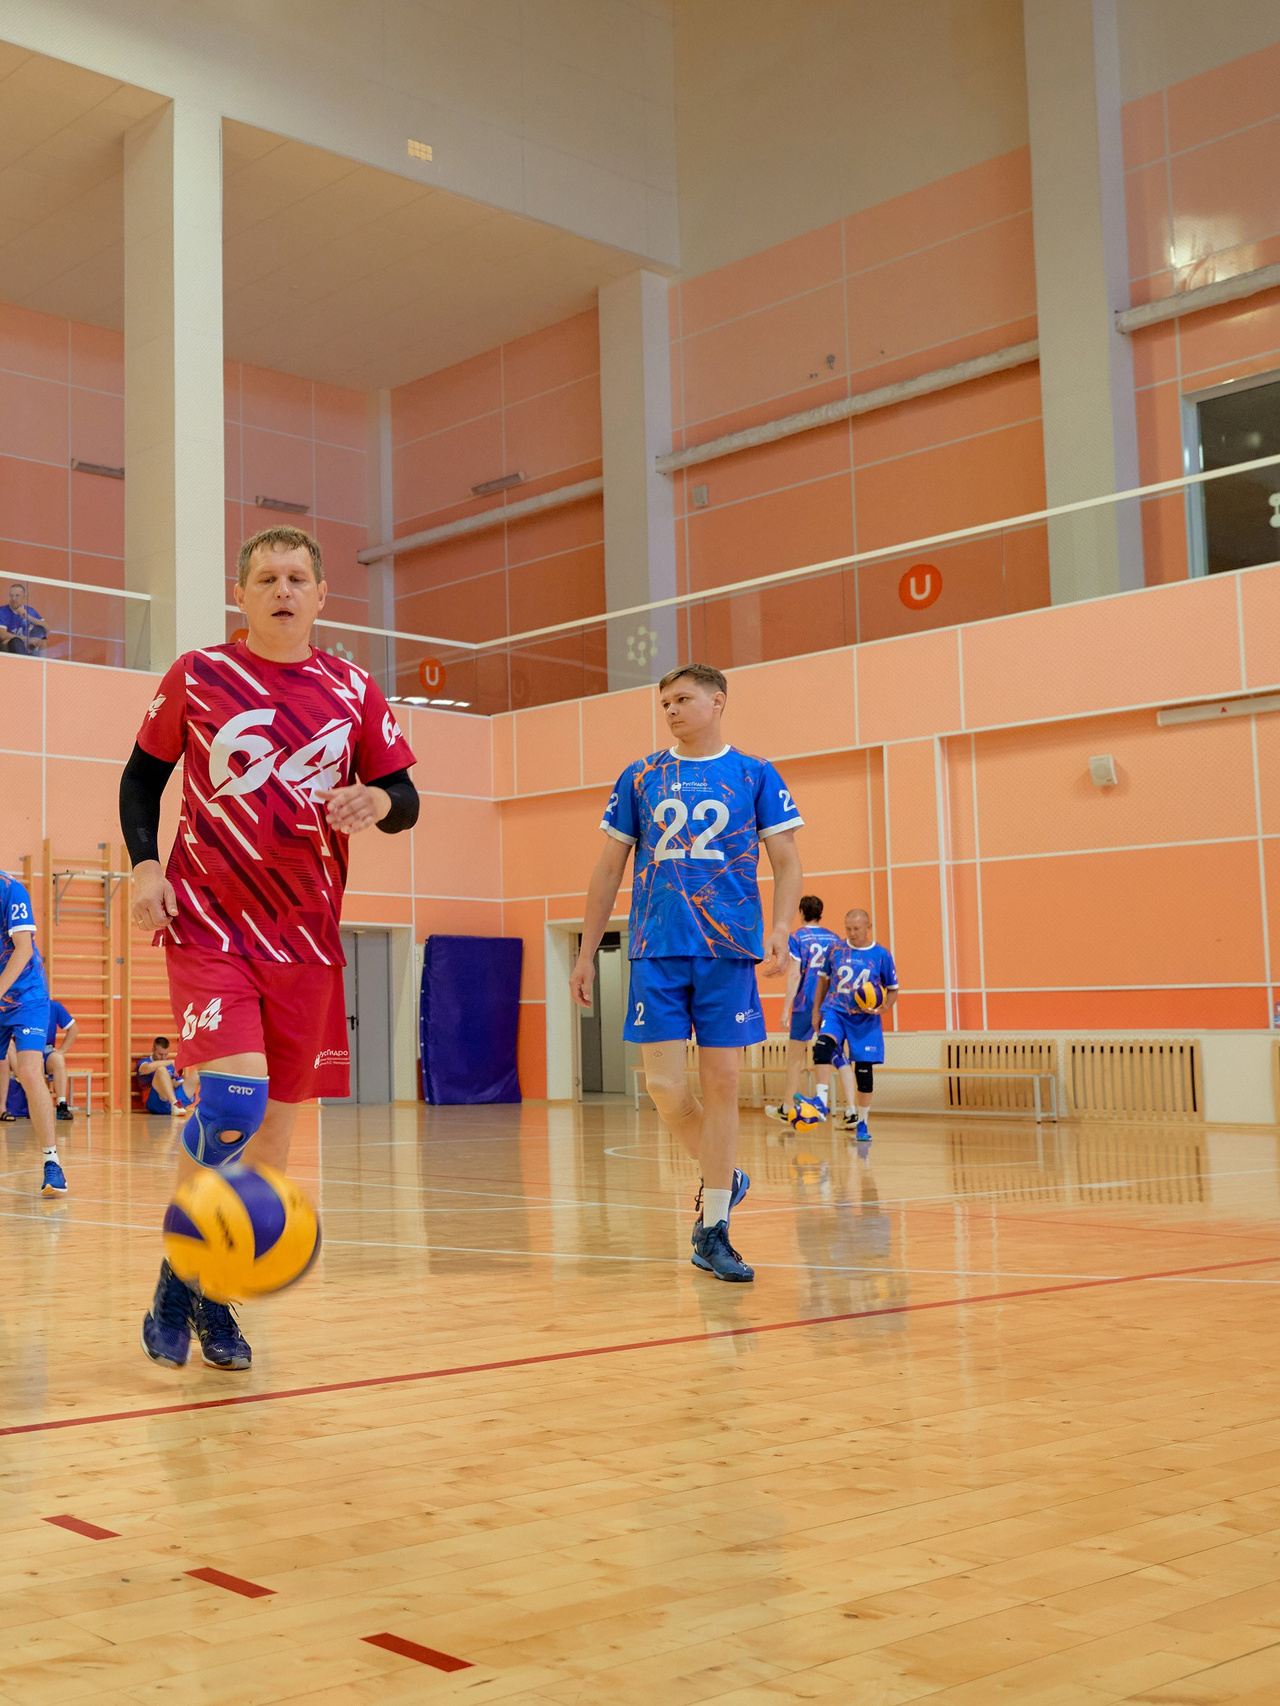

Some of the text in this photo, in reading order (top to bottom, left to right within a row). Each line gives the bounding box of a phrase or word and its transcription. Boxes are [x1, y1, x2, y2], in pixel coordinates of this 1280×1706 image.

[910, 574, 931, 600] U
[425, 664, 440, 686] U
[207, 708, 352, 805] 64
[653, 798, 730, 861] 22
[11, 902, 29, 920] 23
[837, 965, 871, 994] 24
[182, 997, 223, 1041] 64
